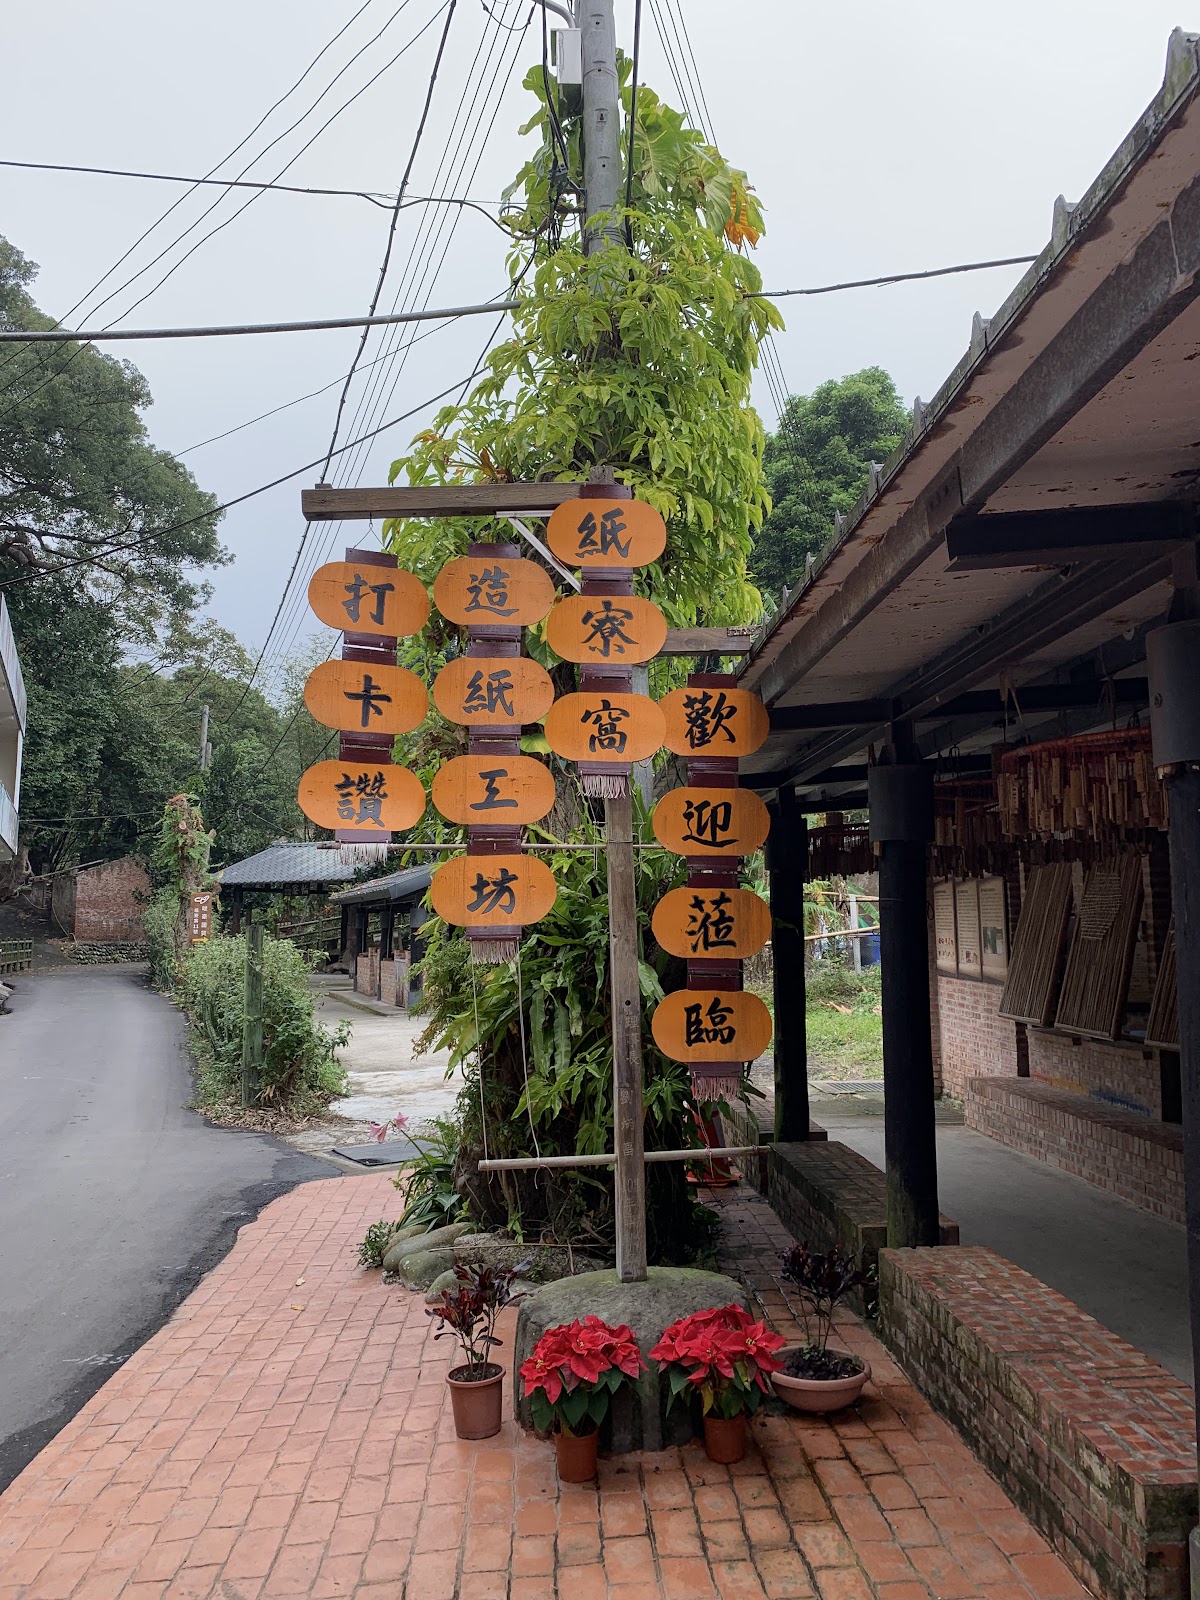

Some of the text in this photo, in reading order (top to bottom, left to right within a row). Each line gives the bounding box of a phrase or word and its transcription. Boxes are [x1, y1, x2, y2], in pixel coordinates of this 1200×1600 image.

[335, 573, 395, 828] 打卡讚
[464, 566, 520, 915] 造紙工坊
[576, 508, 638, 754] 紙寮窩
[683, 692, 738, 1047] 歡迎蒞臨
